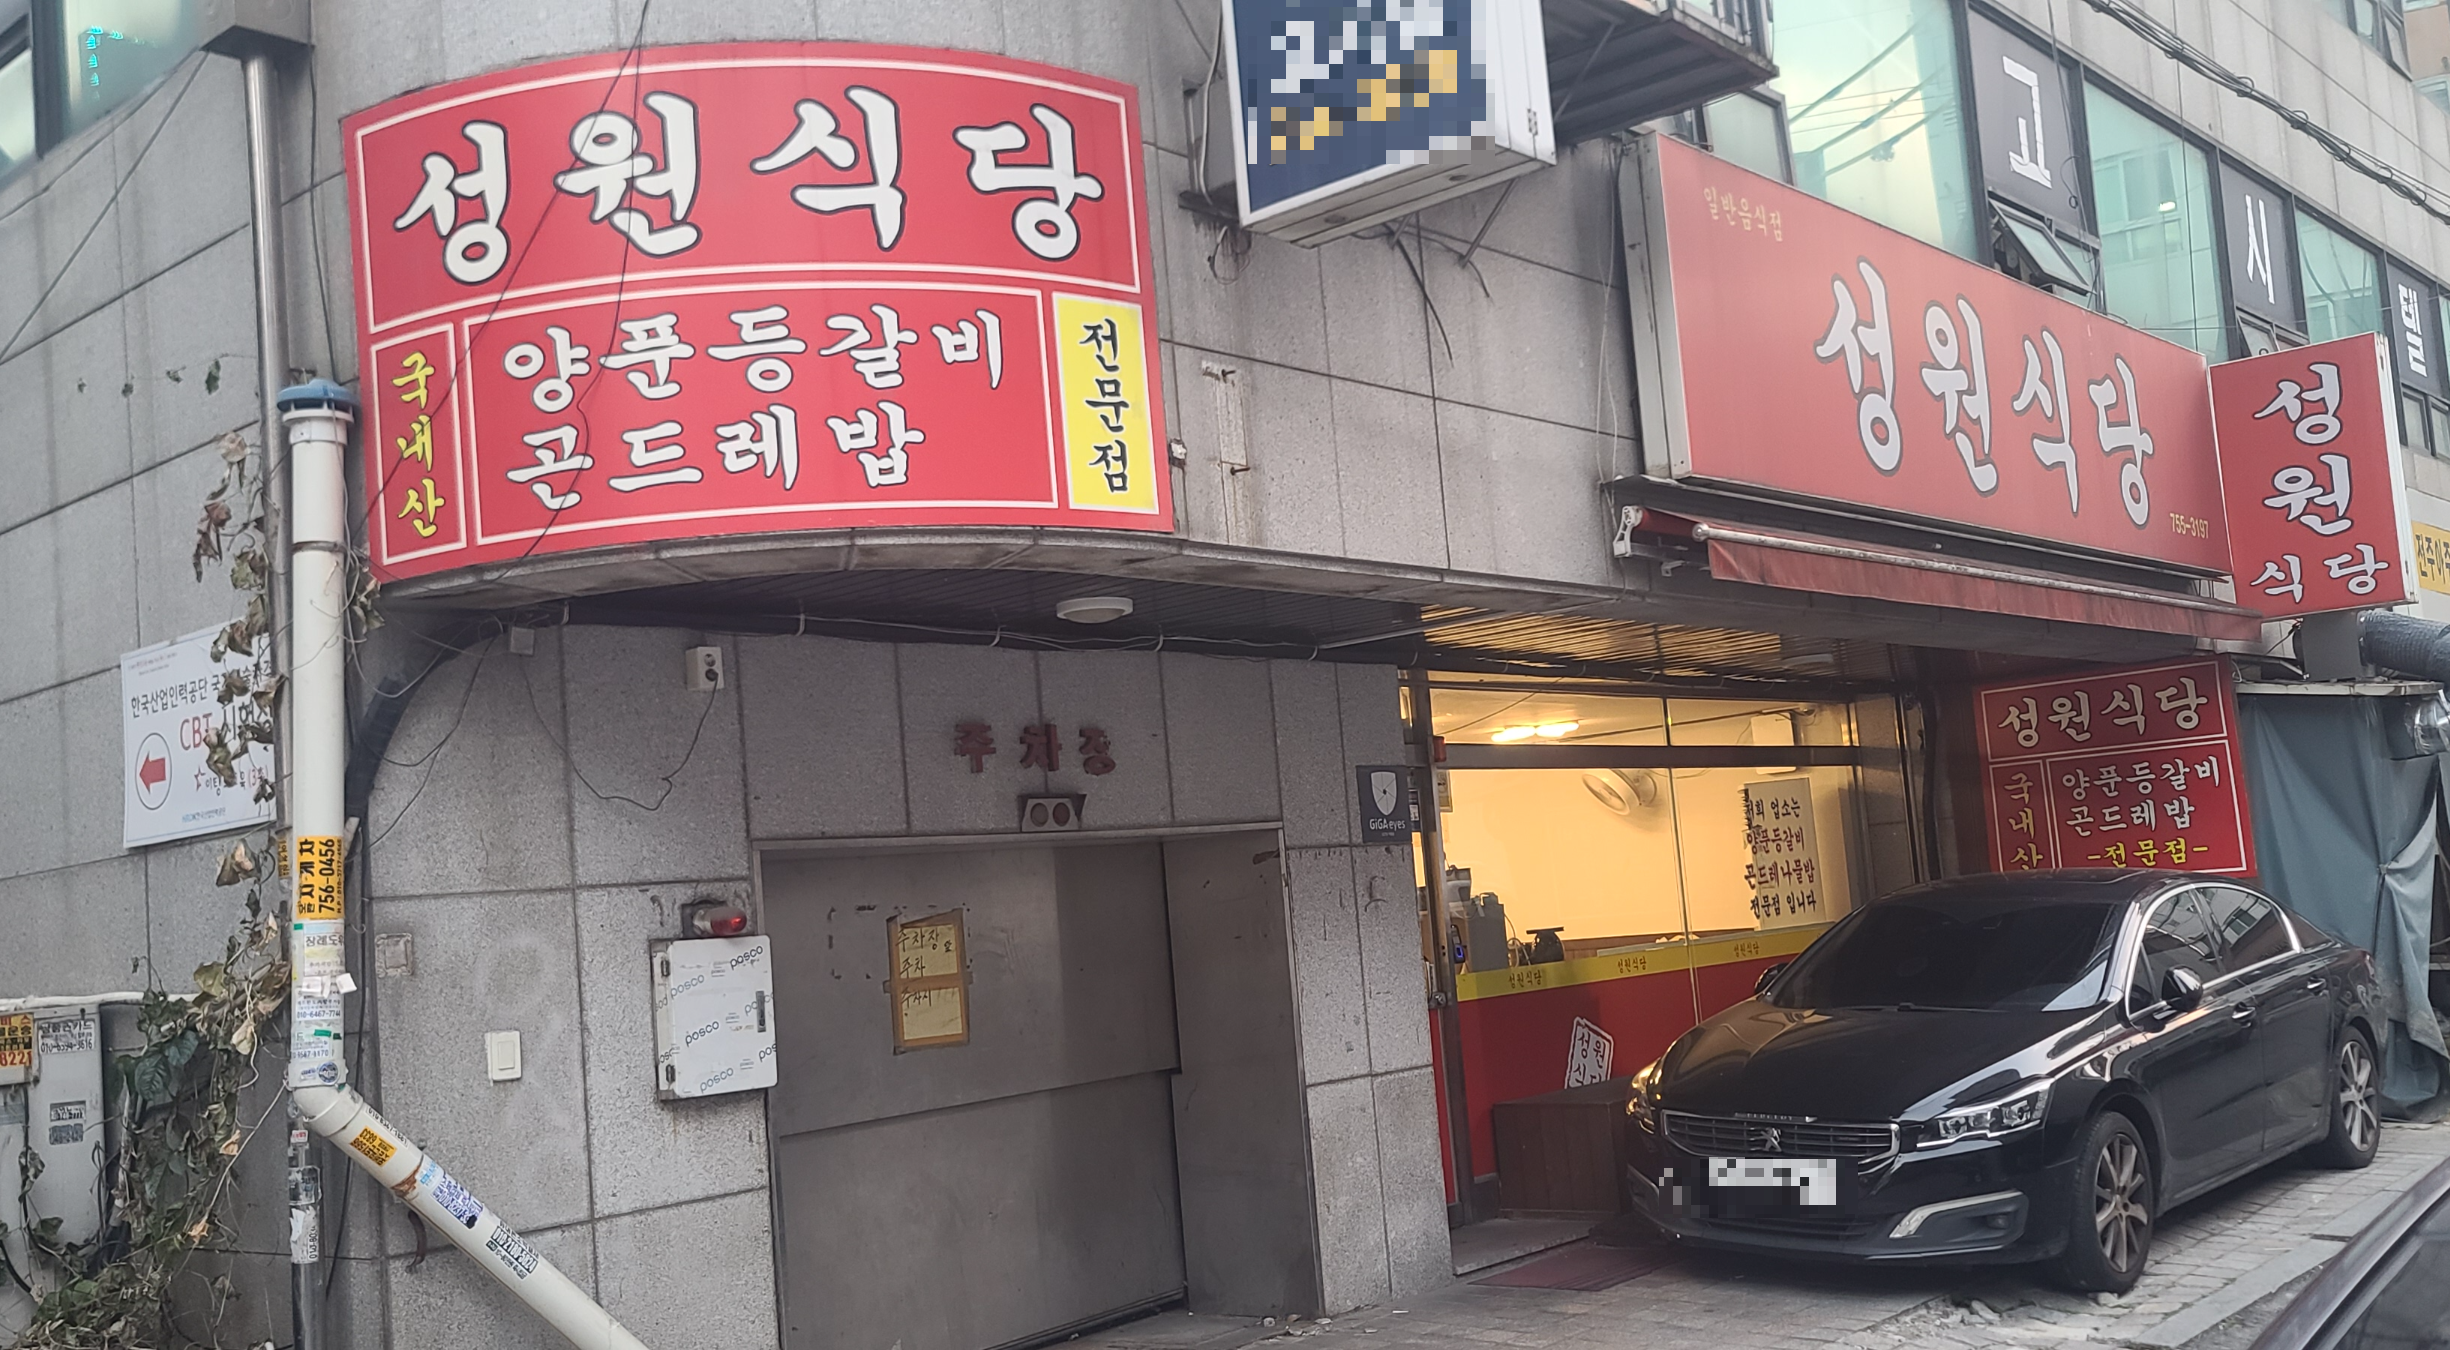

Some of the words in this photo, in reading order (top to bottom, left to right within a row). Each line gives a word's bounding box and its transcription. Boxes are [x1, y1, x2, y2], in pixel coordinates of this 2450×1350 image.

[394, 85, 1105, 284] 성원식당
[1703, 186, 1783, 241] 일반음식점
[503, 303, 1004, 413] 양푼등갈비
[1078, 318, 1130, 494] 전문점
[1815, 256, 2154, 528] 성원식당
[392, 351, 446, 538] 국내산
[504, 400, 926, 511] 곤드레밥
[2170, 513, 2209, 539] 755-3197
[131, 677, 208, 719] 한국산업인력공단
[1998, 677, 2208, 748] 성원식당
[2062, 755, 2221, 801] 양푼등갈비
[1770, 797, 1801, 820] 업소는
[2066, 796, 2195, 837] 곤드레밥
[1746, 826, 1805, 855] 양푼등갈비
[318, 839, 335, 913] 756-0456
[1750, 893, 1781, 919] 전문점
[1786, 889, 1817, 914] 입니다
[730, 946, 763, 970] posco
[1617, 955, 1647, 974] 성원식당
[670, 974, 705, 999] posco
[1508, 969, 1542, 989] 성원식당
[685, 1021, 720, 1047] posco
[699, 1068, 734, 1094] posco
